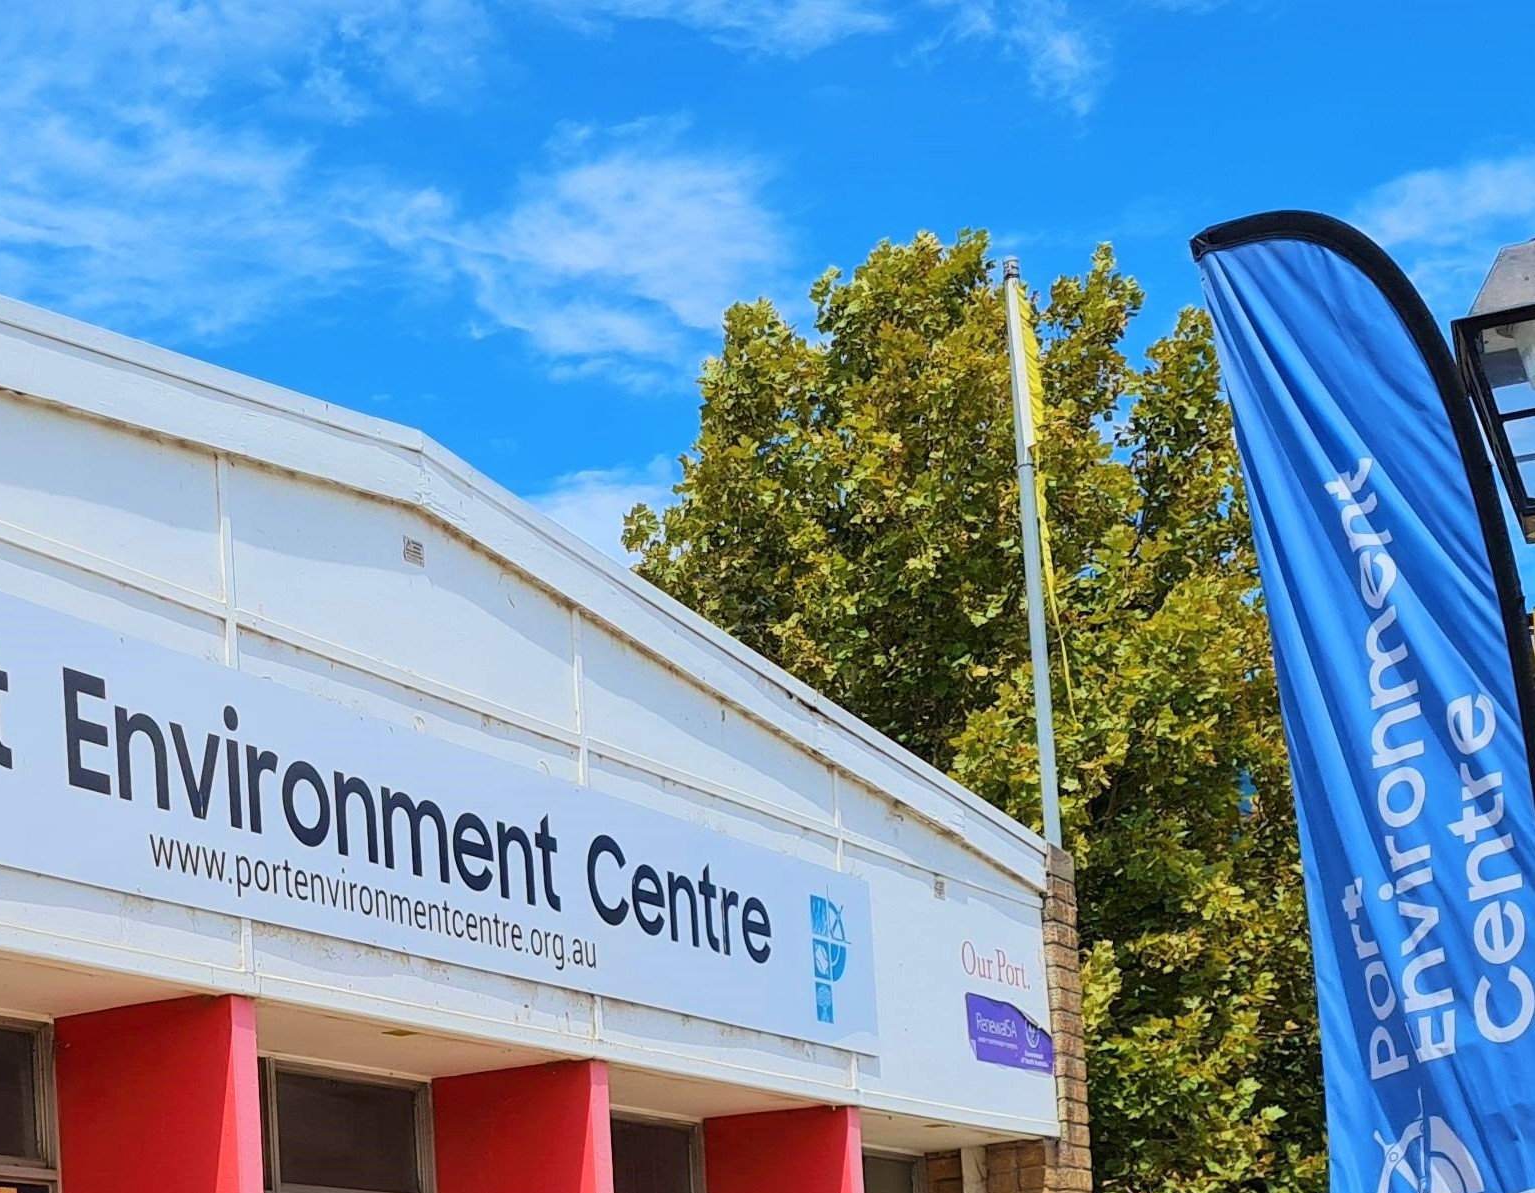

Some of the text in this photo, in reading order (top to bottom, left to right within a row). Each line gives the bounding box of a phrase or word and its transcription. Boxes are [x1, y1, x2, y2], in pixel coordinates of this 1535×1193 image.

[62, 666, 561, 911] Environment
[587, 834, 772, 964] Centre
[1324, 457, 1456, 1062] Environment
[1447, 693, 1534, 1043] Centre
[149, 832, 597, 971] www.portenvironmentcentre.org.au
[961, 941, 1031, 990] Our Port.
[1342, 876, 1409, 1080] Port
